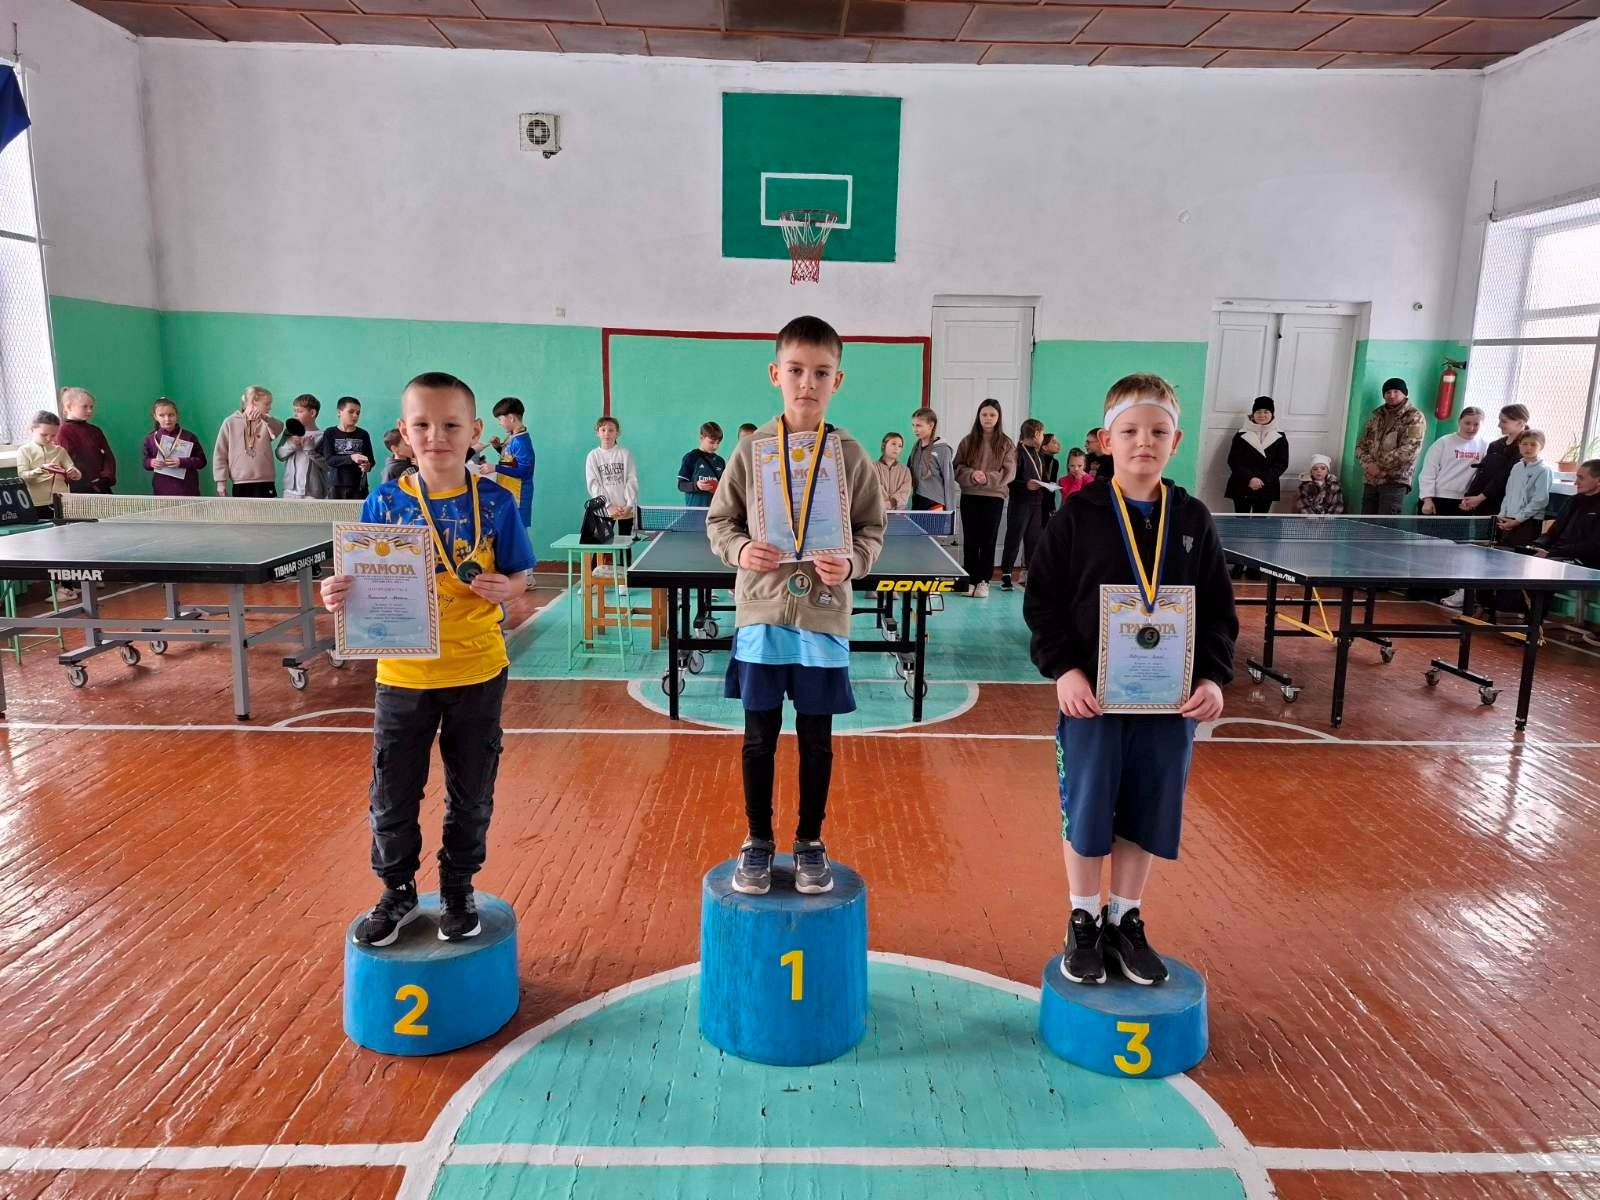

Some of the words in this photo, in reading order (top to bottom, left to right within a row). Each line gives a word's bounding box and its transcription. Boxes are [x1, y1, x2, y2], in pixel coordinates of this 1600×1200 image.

[48, 568, 103, 581] TIBHAR
[273, 561, 297, 578] TIBHAR
[353, 562, 416, 575] ГРАМОТА
[876, 579, 955, 592] DONIC
[780, 950, 804, 1001] 1
[393, 984, 429, 1036] 2
[1113, 1021, 1152, 1075] 3
